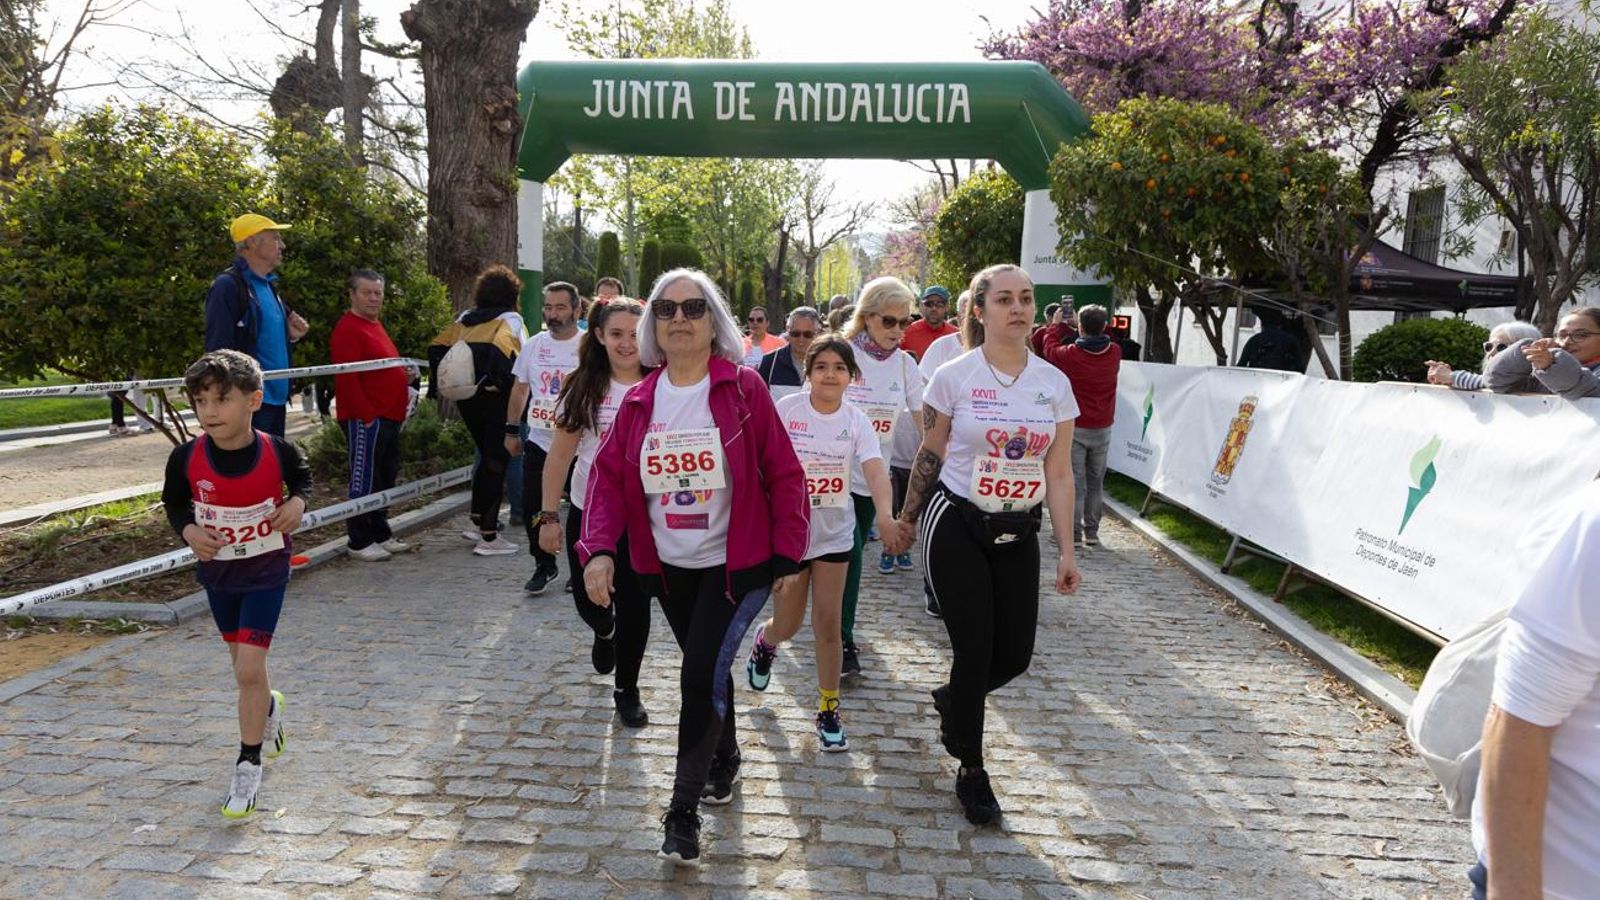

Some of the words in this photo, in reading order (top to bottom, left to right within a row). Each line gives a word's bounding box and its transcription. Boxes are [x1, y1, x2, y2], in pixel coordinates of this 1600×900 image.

[583, 80, 694, 119] JUNTA
[713, 81, 756, 121] DE
[774, 82, 971, 123] ANDALUCIA
[1033, 254, 1057, 265] Junta
[972, 387, 997, 400] XXVII
[532, 407, 557, 421] 562
[872, 420, 892, 433] 05
[647, 450, 716, 476] 5386
[806, 478, 844, 495] 629
[978, 477, 1041, 499] 5627
[205, 518, 273, 545] 320
[1356, 527, 1388, 549] Patronato
[1389, 539, 1425, 562] Municipal
[1424, 552, 1436, 568] de
[1355, 544, 1388, 567] Deportes
[1388, 557, 1399, 571] de
[1398, 561, 1419, 579] Jaén
[33, 587, 76, 605] DEPORTES
